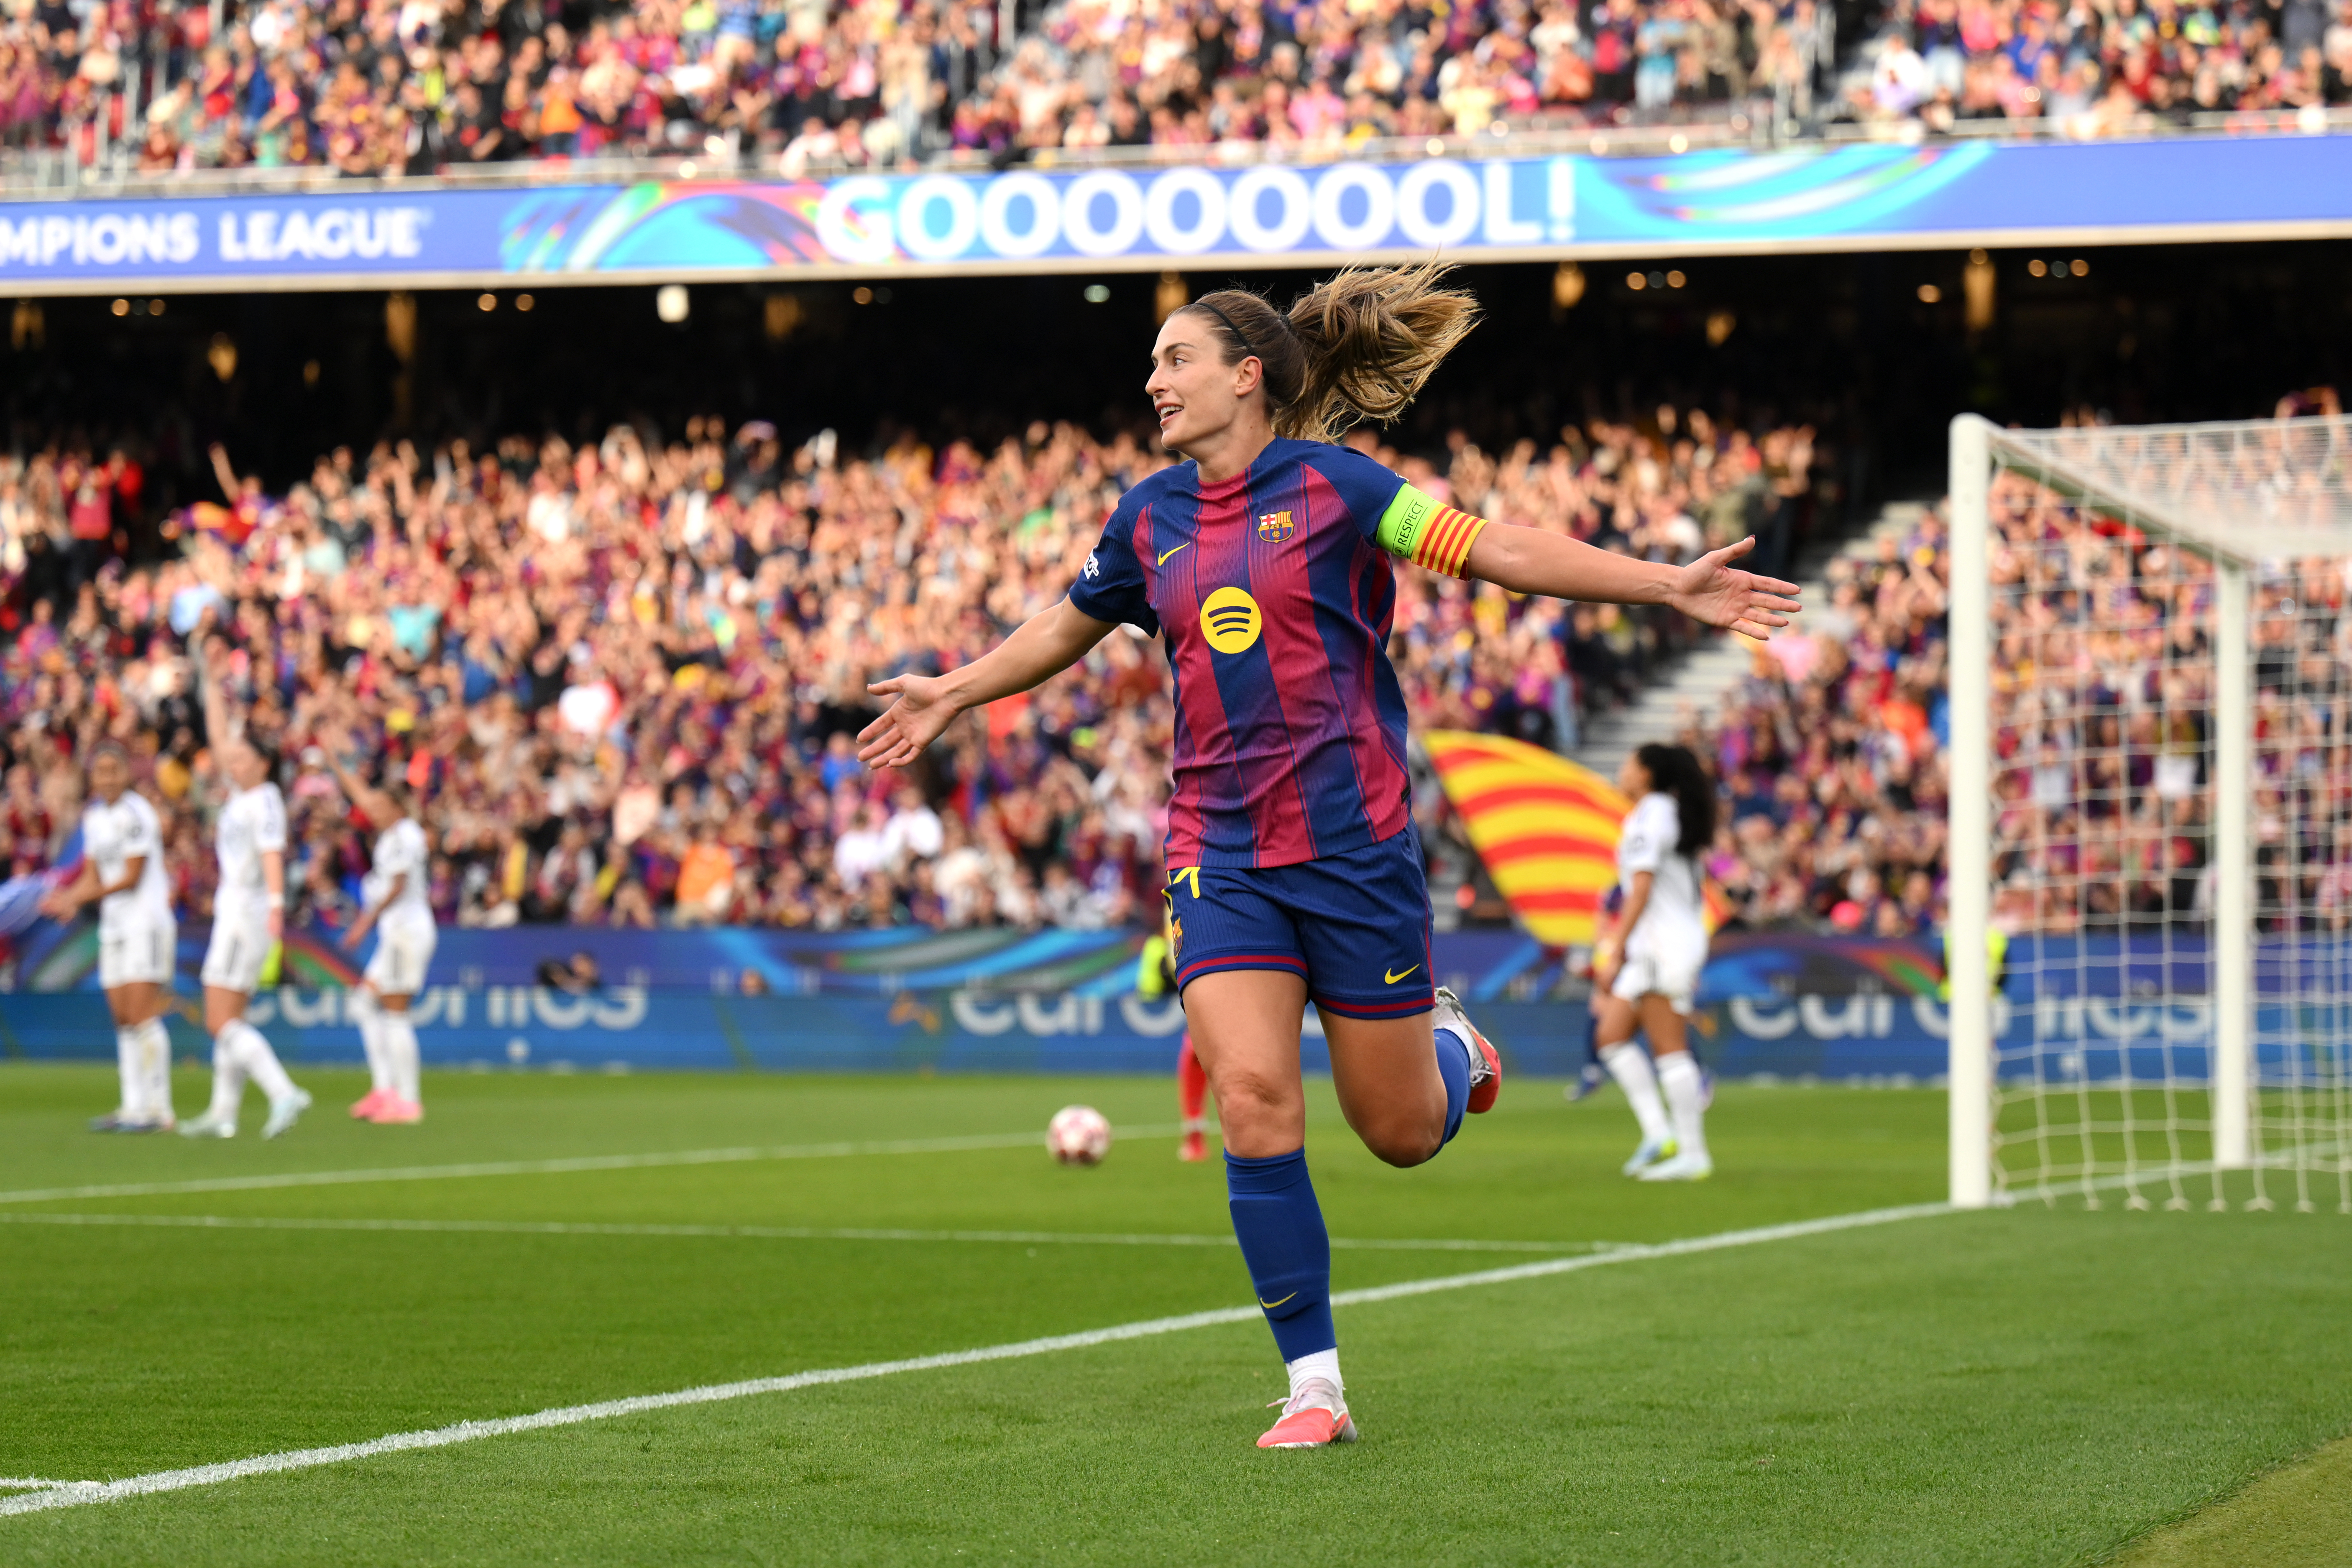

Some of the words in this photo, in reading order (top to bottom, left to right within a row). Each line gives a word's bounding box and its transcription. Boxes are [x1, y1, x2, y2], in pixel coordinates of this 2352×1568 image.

[0, 212, 199, 266] MPIONS
[219, 208, 422, 261] LEAGUE
[816, 157, 1575, 262] GOOOOOOOL!
[1397, 501, 1424, 546] RESPECT
